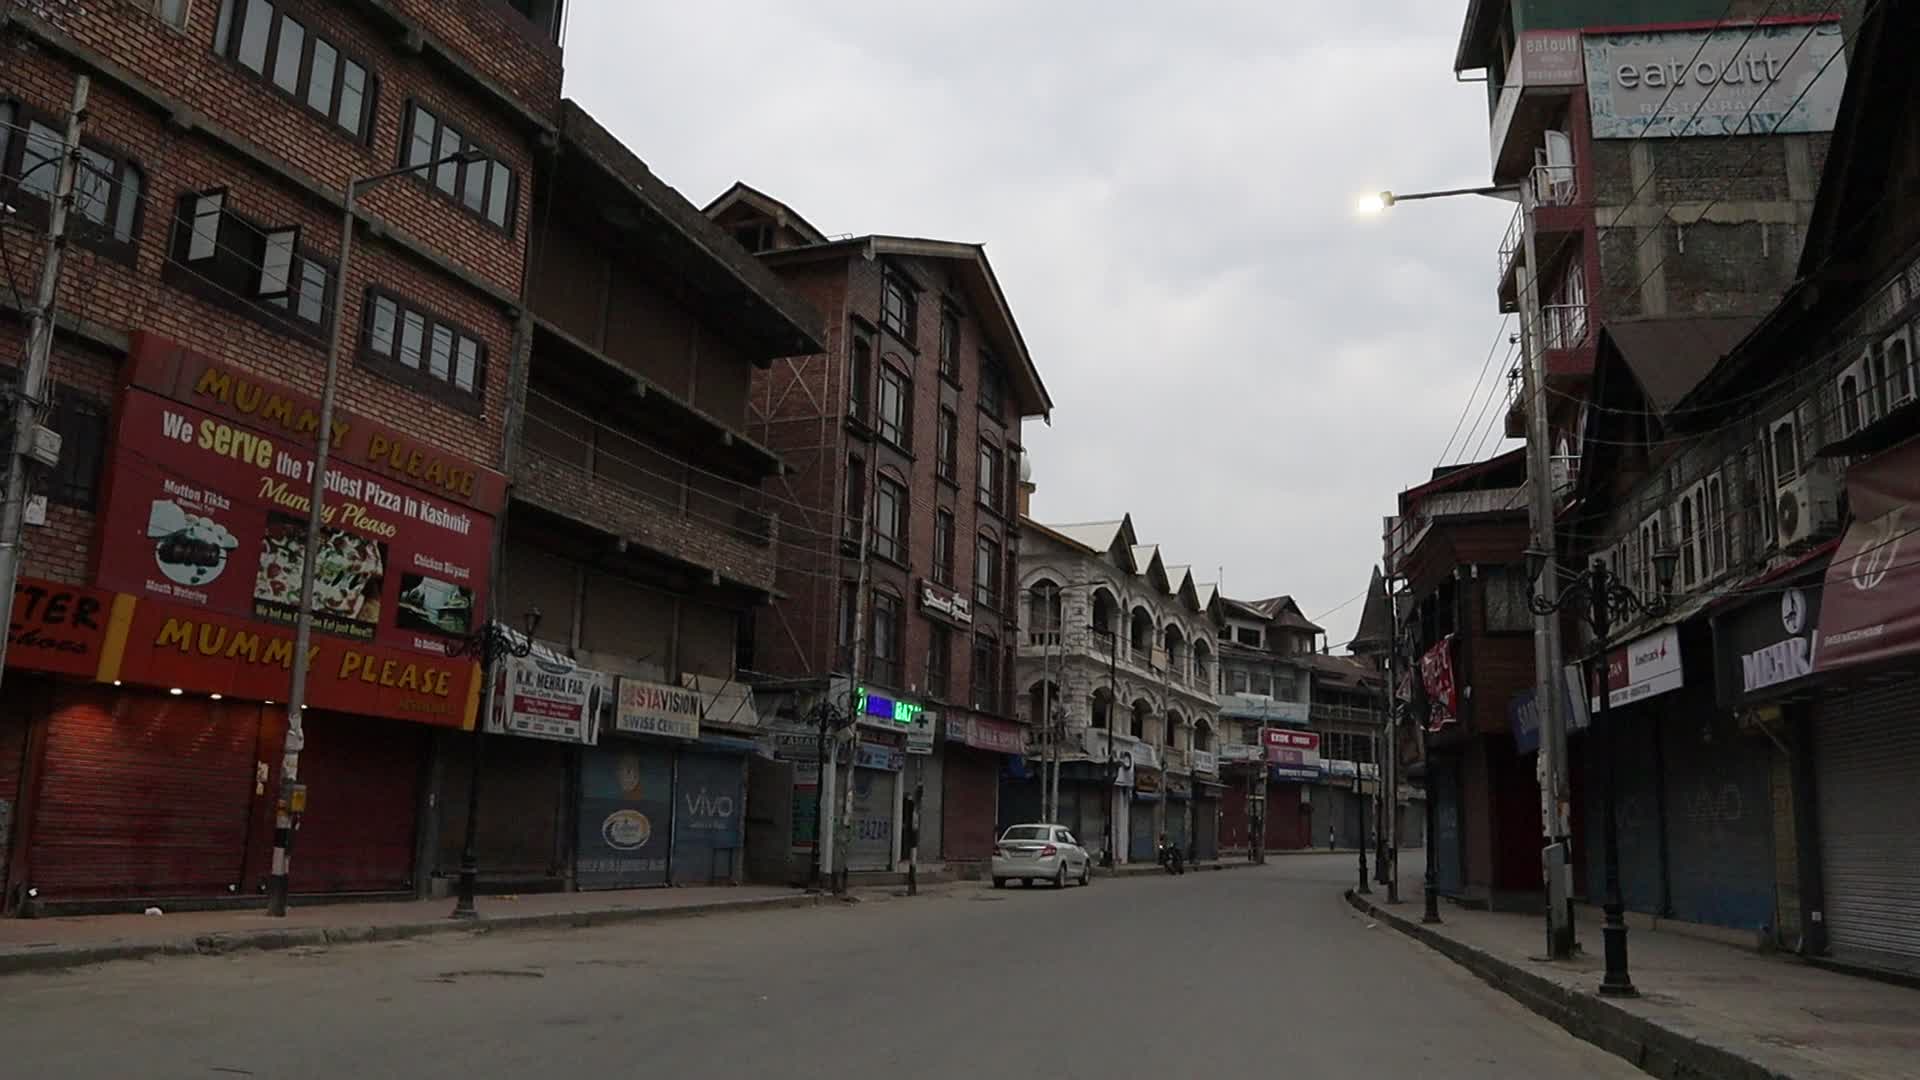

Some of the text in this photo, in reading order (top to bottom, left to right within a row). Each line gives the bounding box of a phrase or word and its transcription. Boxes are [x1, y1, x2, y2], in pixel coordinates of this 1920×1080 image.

[162, 410, 194, 444] We
[197, 418, 273, 470] serve
[275, 450, 302, 480] the
[306, 459, 362, 501] Tstiest
[364, 481, 401, 514] Pizza
[420, 500, 471, 536] Kashmir
[368, 431, 475, 498] PLEASE
[257, 475, 336, 524] Mumy
[340, 502, 398, 539] Please
[154, 617, 452, 697] MUMMY PLEASE
[536, 673, 566, 693] MEHRA
